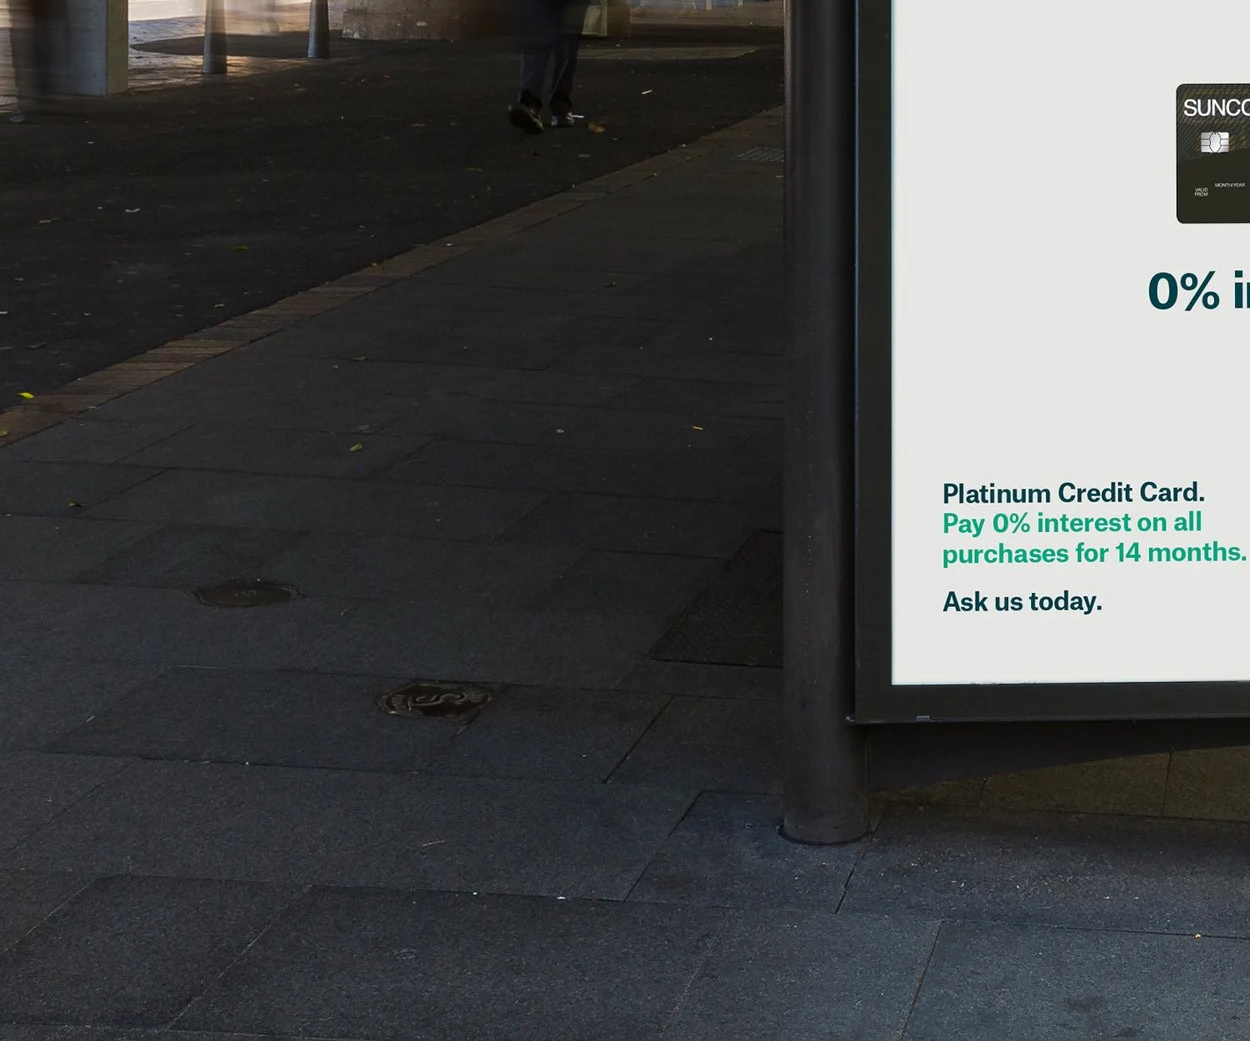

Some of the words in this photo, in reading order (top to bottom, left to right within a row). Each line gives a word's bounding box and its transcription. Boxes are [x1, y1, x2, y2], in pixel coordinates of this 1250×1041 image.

[1148, 270, 1221, 312] 0%
[943, 482, 1051, 505] Platinum
[1057, 481, 1134, 504] Credit
[1139, 480, 1205, 503] Card.
[943, 513, 986, 539] Pay
[992, 511, 1031, 534] 0%
[1037, 511, 1132, 533] interest
[1136, 516, 1168, 532] on
[1173, 510, 1202, 532] all
[942, 542, 1070, 569] purchases
[1074, 541, 1110, 563] for
[1115, 541, 1142, 563] 14
[1148, 540, 1247, 563] months.
[942, 590, 989, 613] Ask
[994, 596, 1024, 612] us
[1028, 589, 1103, 616] today.
